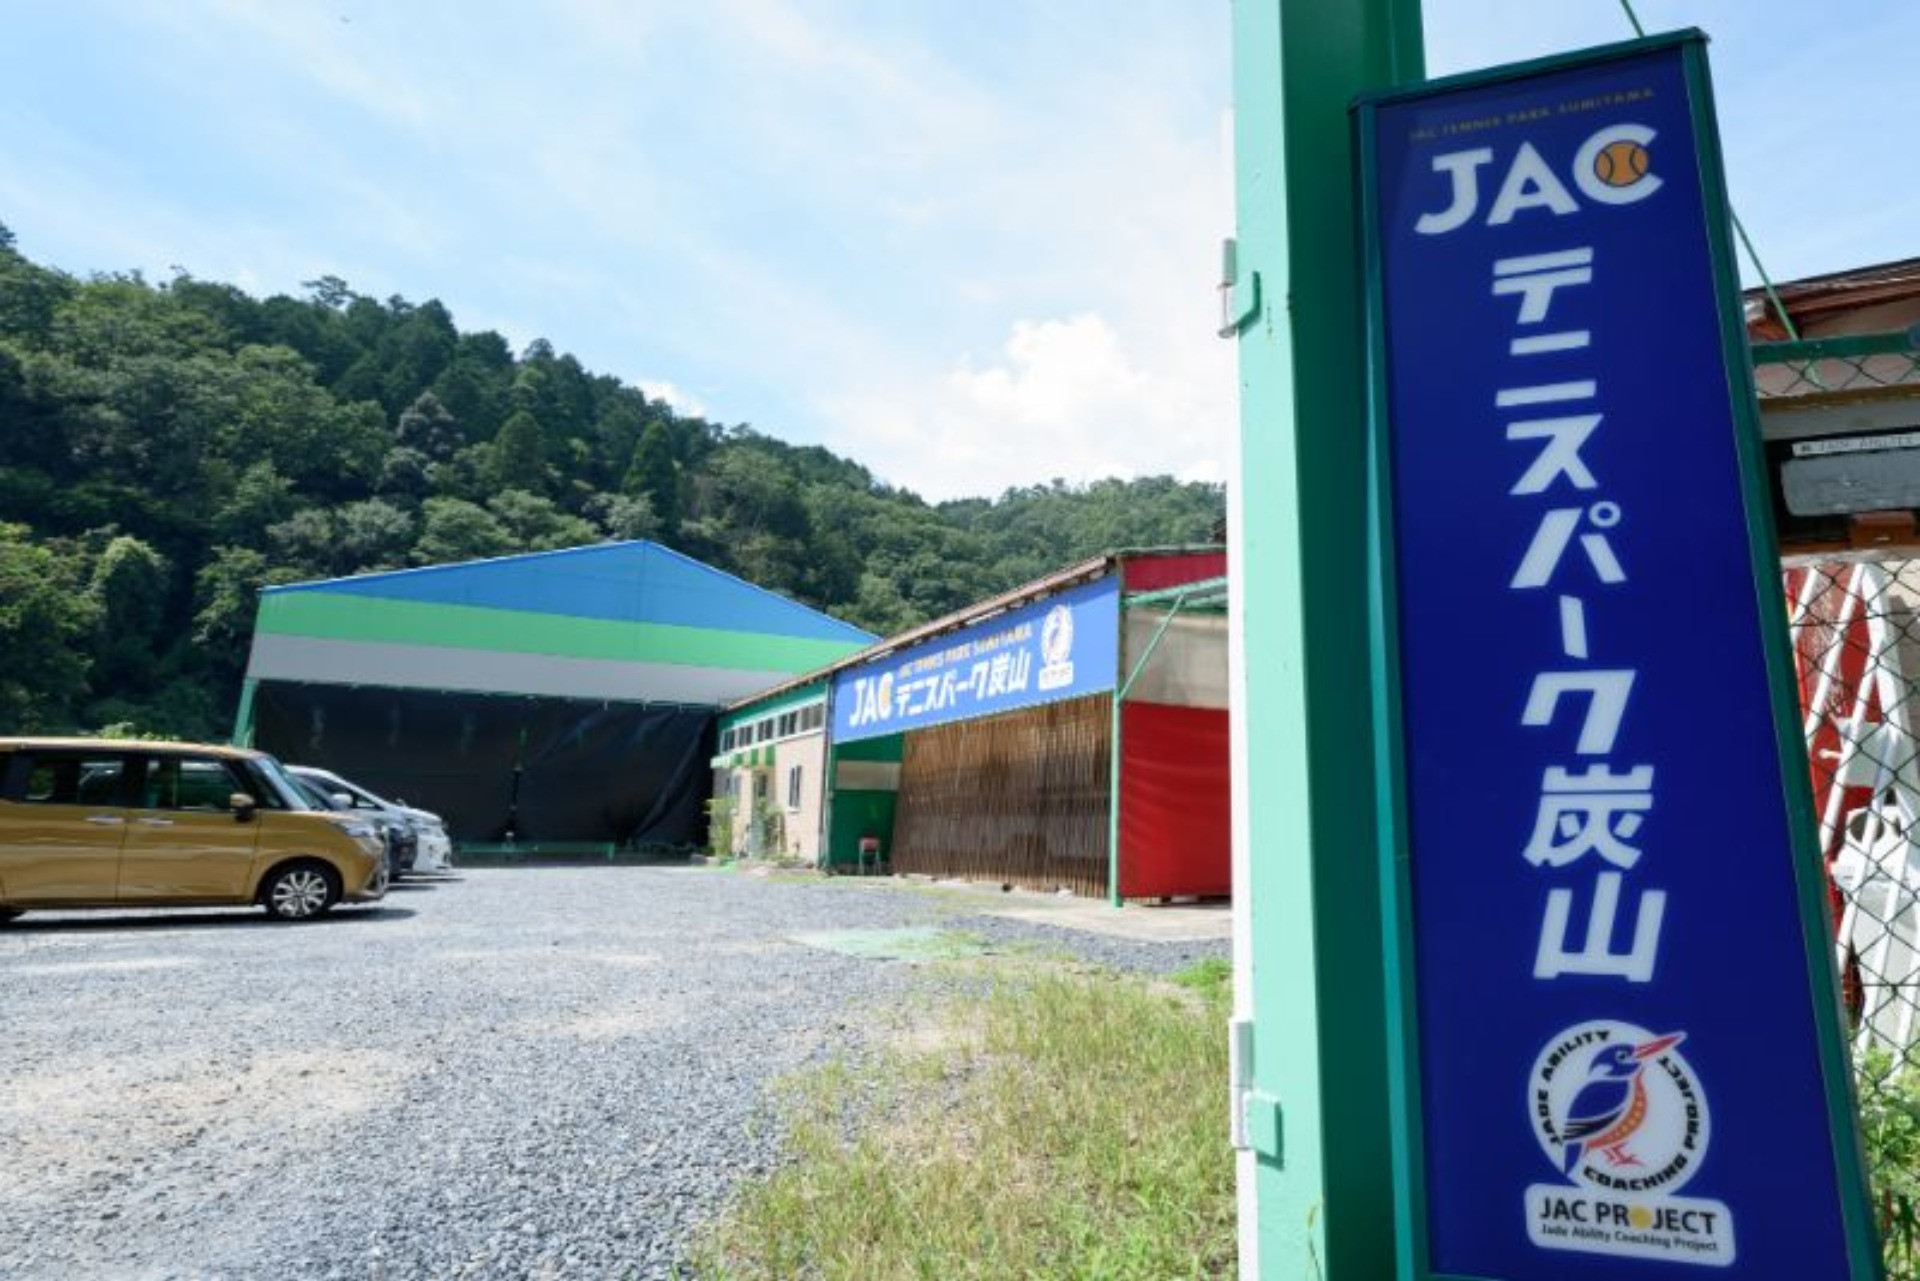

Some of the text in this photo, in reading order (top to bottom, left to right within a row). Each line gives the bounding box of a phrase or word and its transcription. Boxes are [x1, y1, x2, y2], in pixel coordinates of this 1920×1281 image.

[1413, 123, 1665, 235] JAC
[1491, 246, 1667, 982] テニスパーク炭山
[849, 671, 894, 728] JAC
[896, 647, 1032, 718] テニスパーク炭山
[1541, 1029, 1611, 1081] ABILITY
[1583, 1055, 1700, 1191] COACHING PROJECT
[1540, 1197, 1716, 1235] JAC PROJECT
[1572, 1226, 1611, 1243] Ability
[1615, 1230, 1671, 1249] Coaching
[1675, 1236, 1719, 1252] Project
